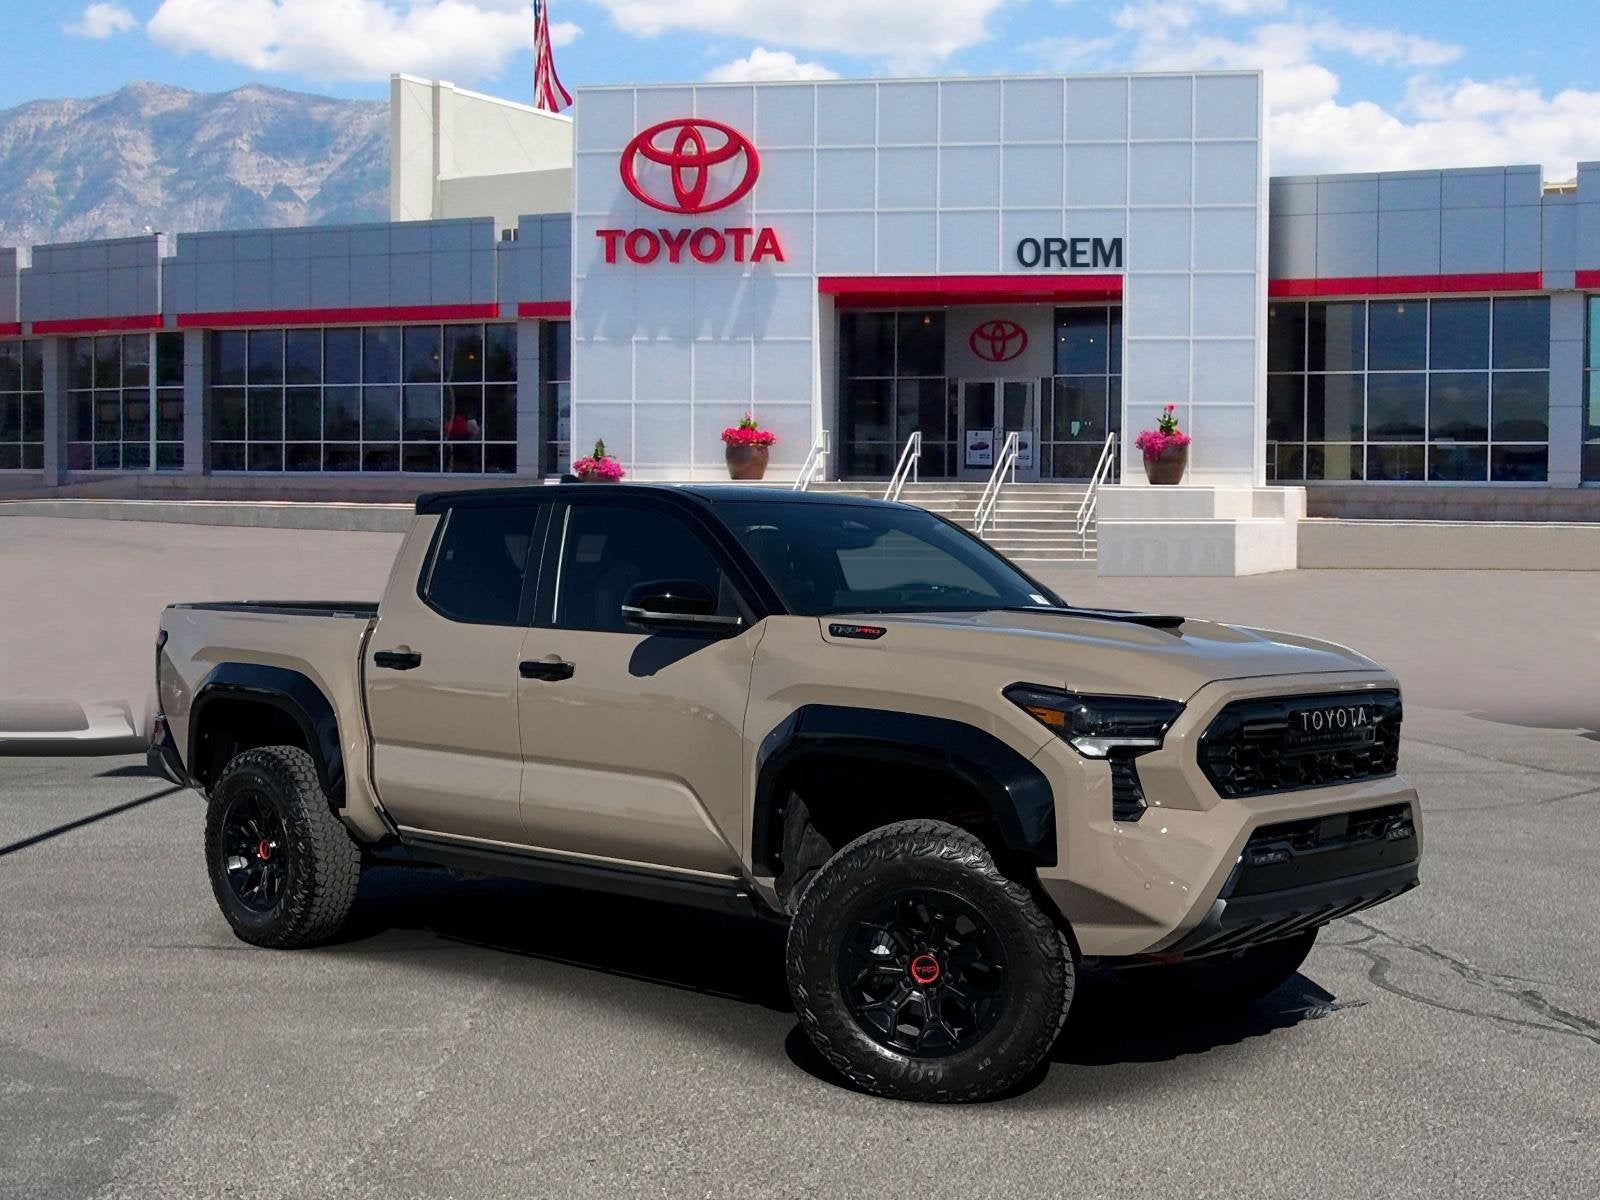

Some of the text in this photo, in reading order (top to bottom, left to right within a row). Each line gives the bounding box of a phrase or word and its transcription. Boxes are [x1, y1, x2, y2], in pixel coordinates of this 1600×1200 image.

[596, 227, 784, 264] TOYOTA
[1017, 237, 1122, 267] OREM
[1301, 707, 1367, 731] TOYOTA
